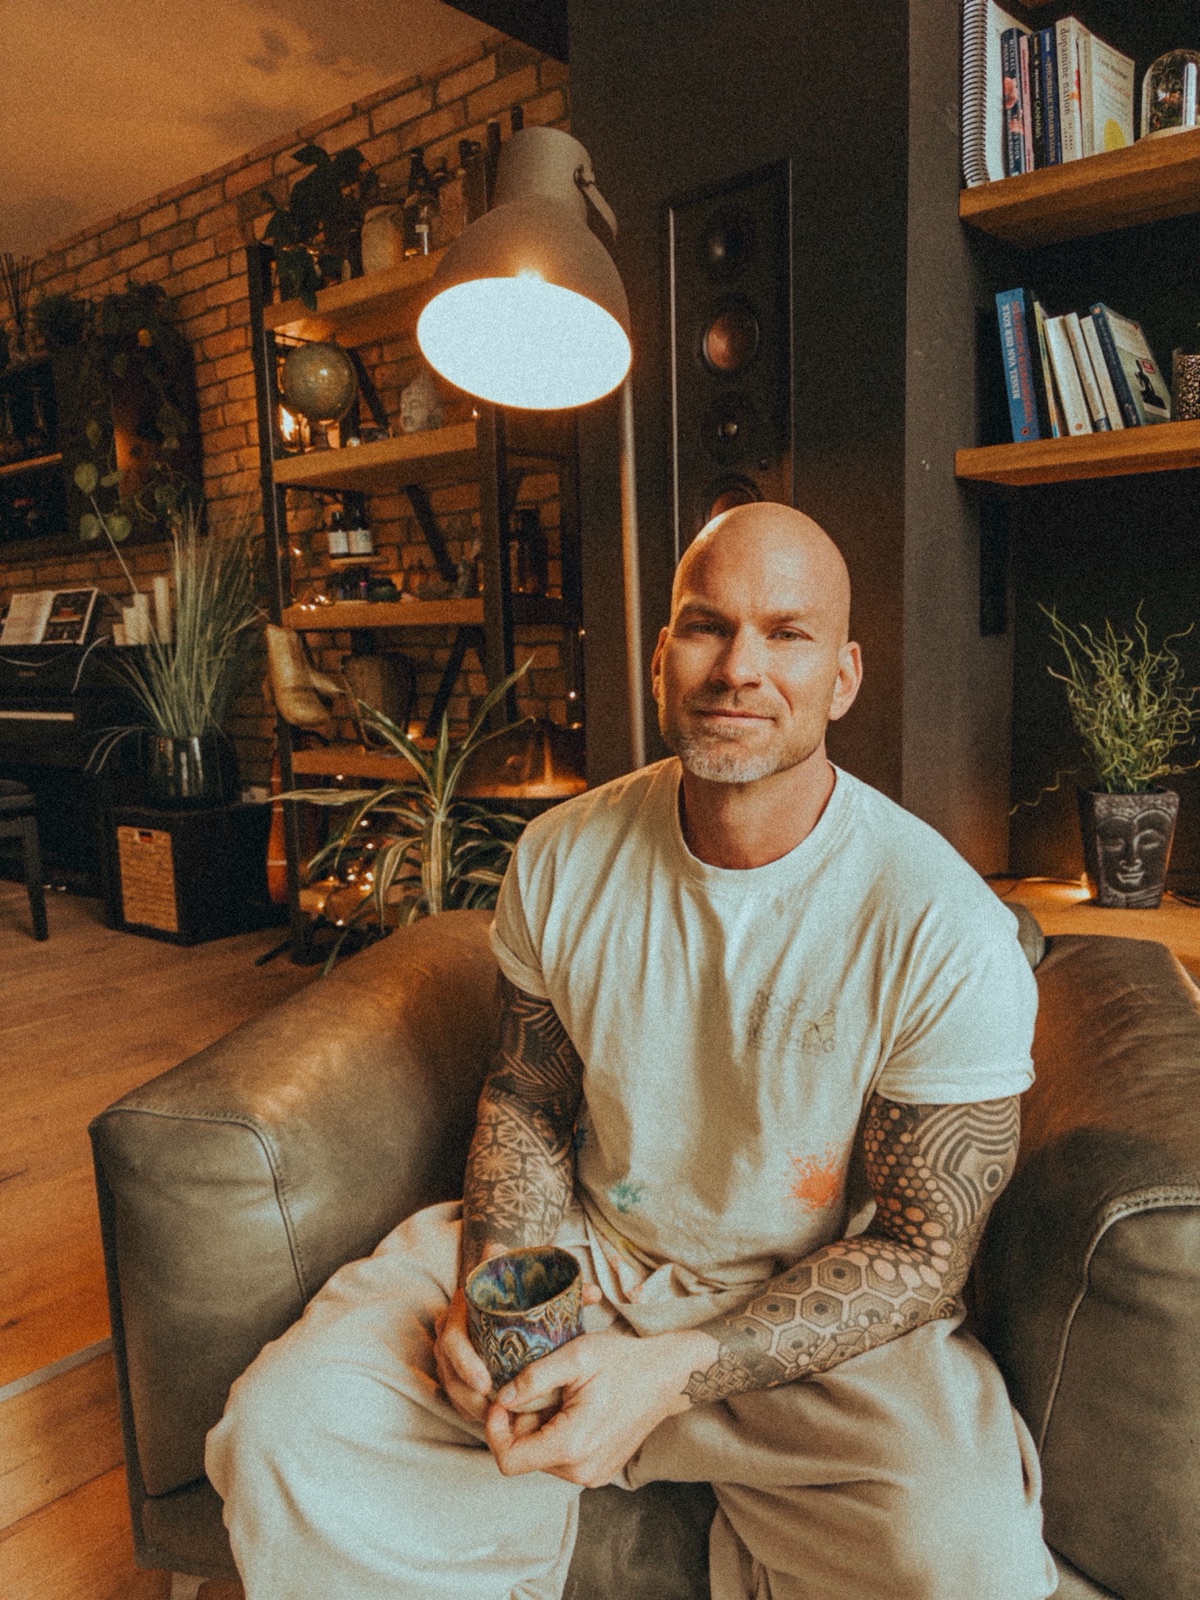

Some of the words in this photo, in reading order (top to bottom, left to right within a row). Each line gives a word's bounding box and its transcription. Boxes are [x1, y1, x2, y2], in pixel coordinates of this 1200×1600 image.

[1059, 28, 1070, 78] dopamine
[1063, 82, 1071, 115] nation
[1034, 100, 1042, 138] CANNABIS
[1002, 303, 1012, 327] KOLK
[1005, 329, 1014, 346] DER
[1006, 348, 1016, 367] VAN
